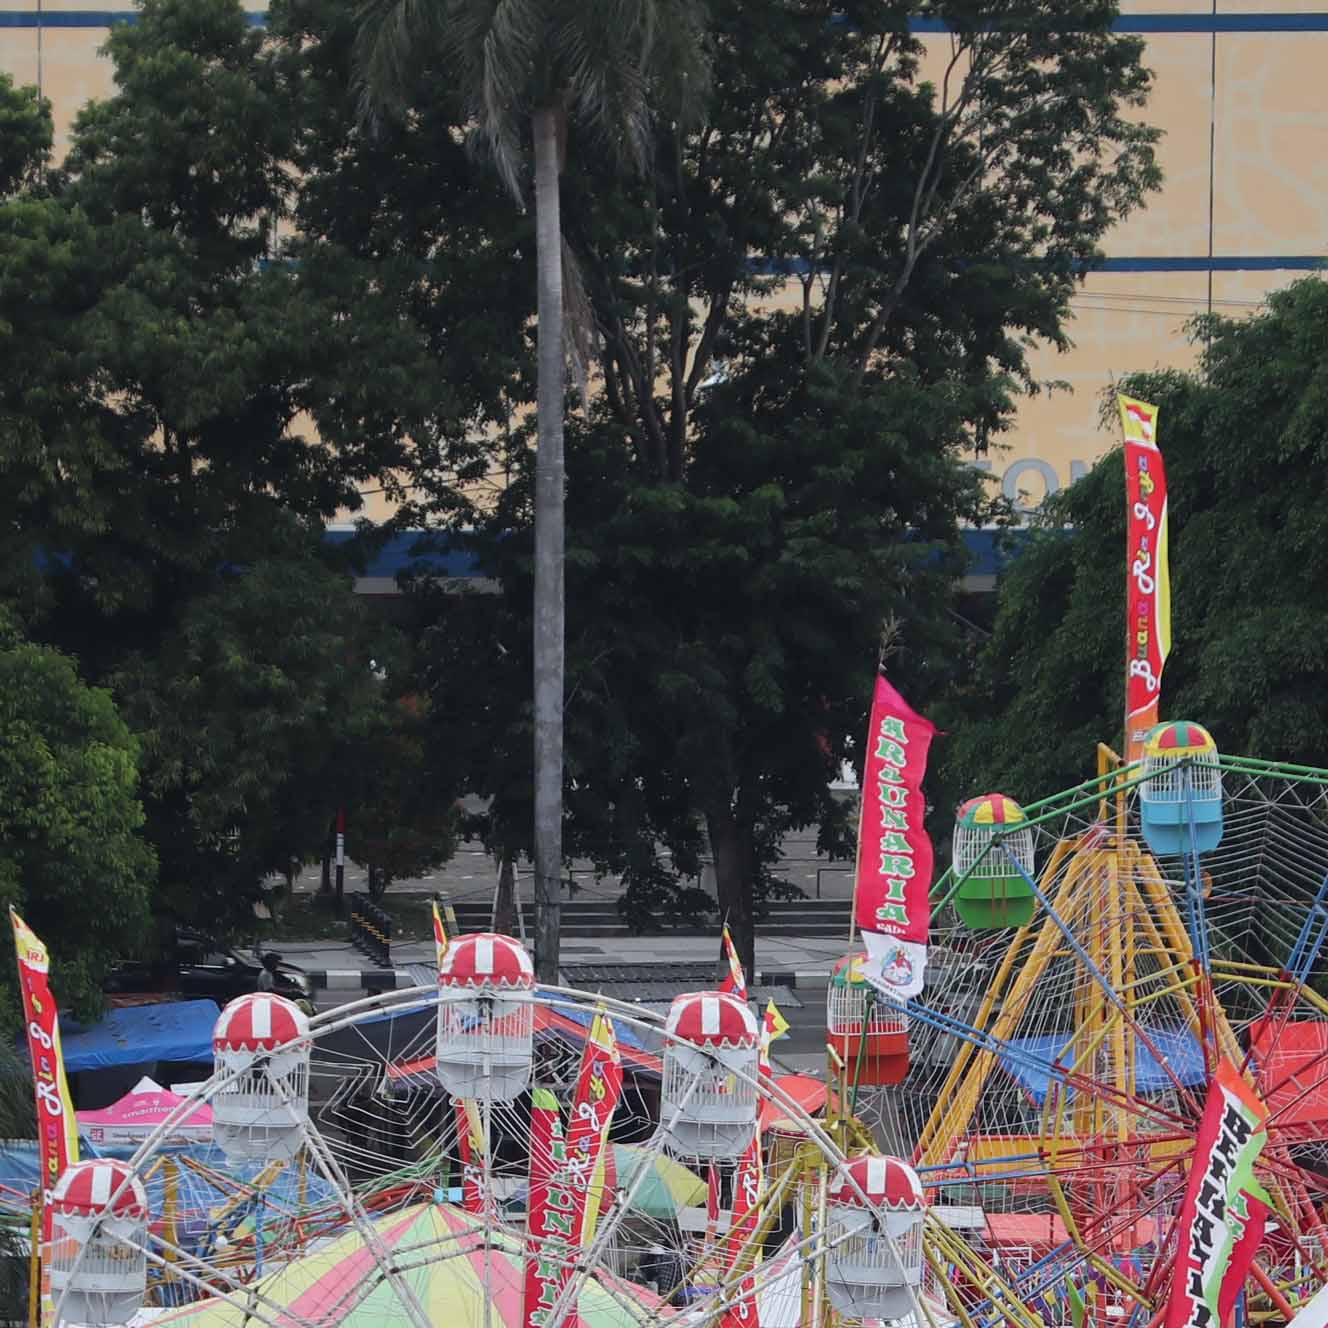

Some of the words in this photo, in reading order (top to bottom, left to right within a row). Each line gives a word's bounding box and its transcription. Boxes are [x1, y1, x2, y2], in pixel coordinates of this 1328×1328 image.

[1133, 536, 1156, 594] Ria
[1130, 603, 1157, 692] Buana
[35, 1054, 63, 1116] Ria
